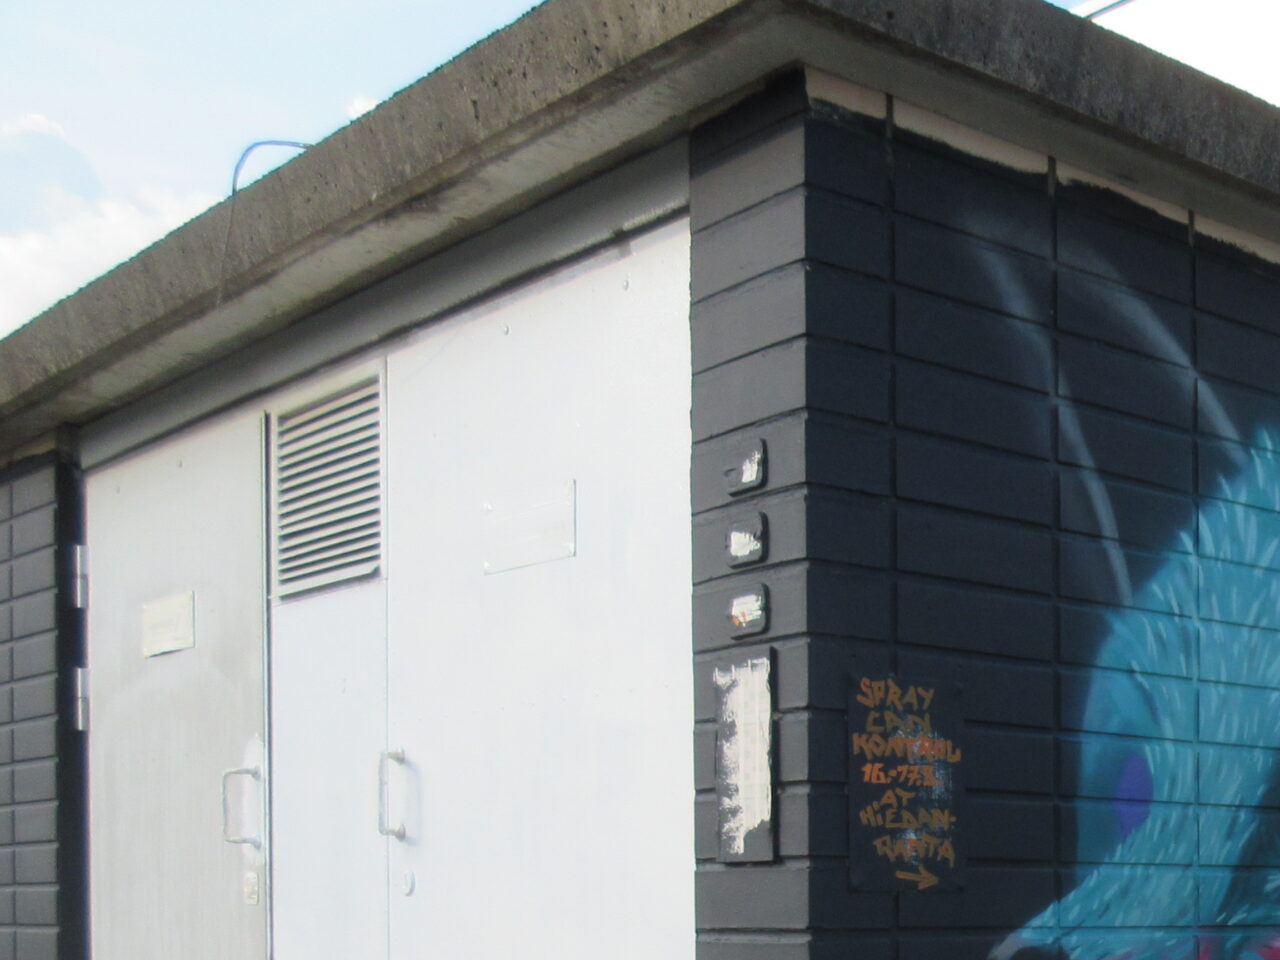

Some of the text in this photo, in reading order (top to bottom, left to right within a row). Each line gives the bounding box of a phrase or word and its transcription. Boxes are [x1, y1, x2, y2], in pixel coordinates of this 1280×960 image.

[856, 676, 935, 710] SPRAY
[865, 710, 932, 735] CAN
[880, 787, 916, 808] AT
[873, 835, 955, 868] RANTA
